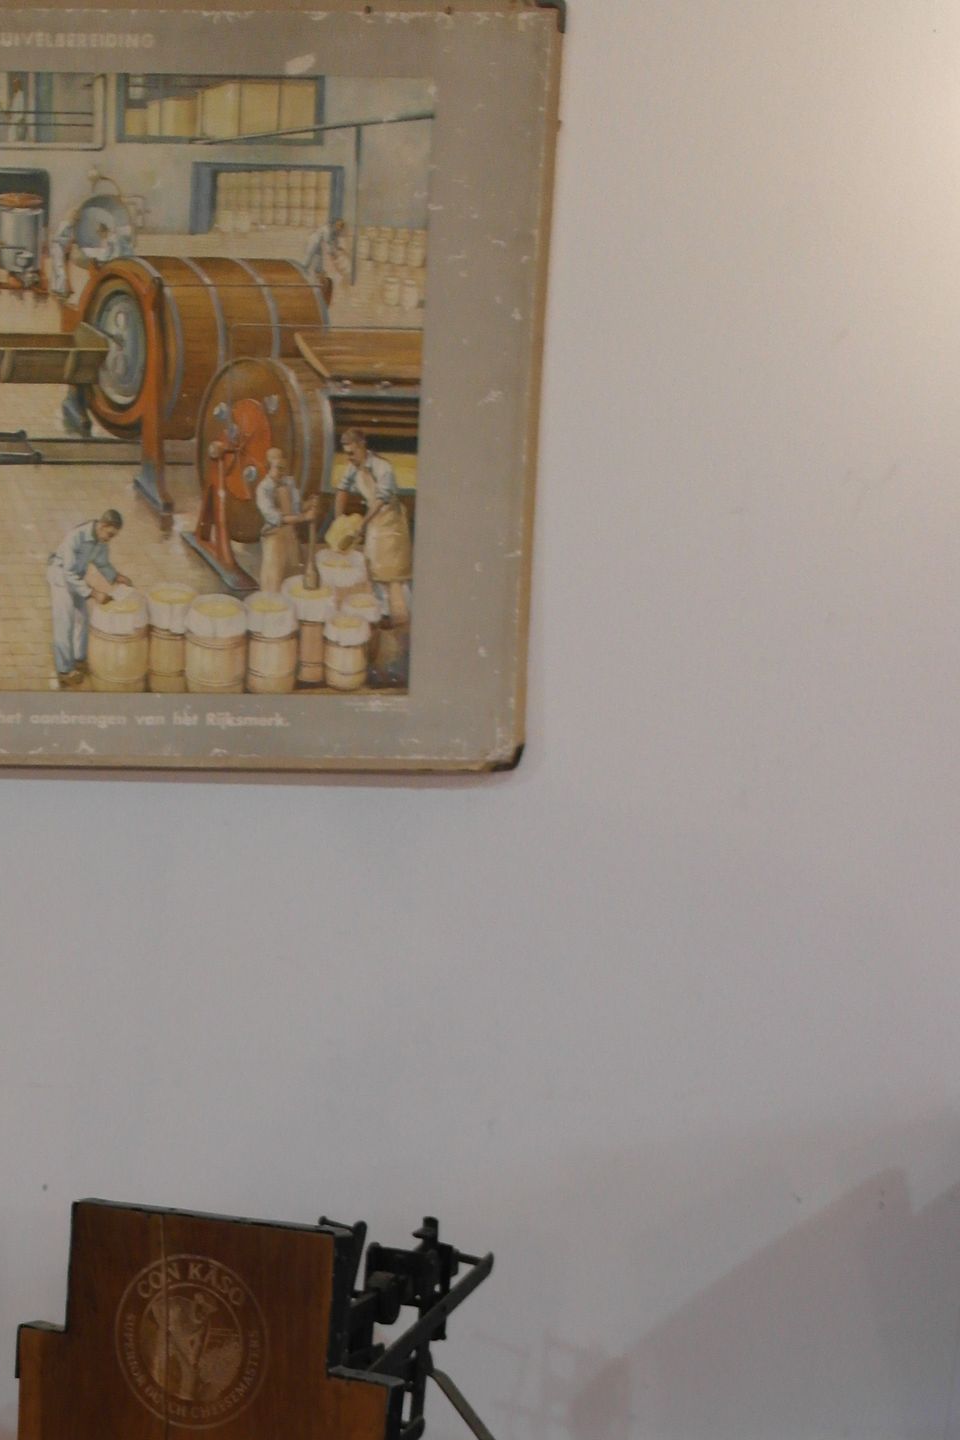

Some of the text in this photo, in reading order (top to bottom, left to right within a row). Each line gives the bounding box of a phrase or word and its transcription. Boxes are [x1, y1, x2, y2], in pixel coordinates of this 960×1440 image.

[30, 710, 127, 728] aanbrengen
[135, 714, 165, 726] van
[172, 711, 198, 726] het
